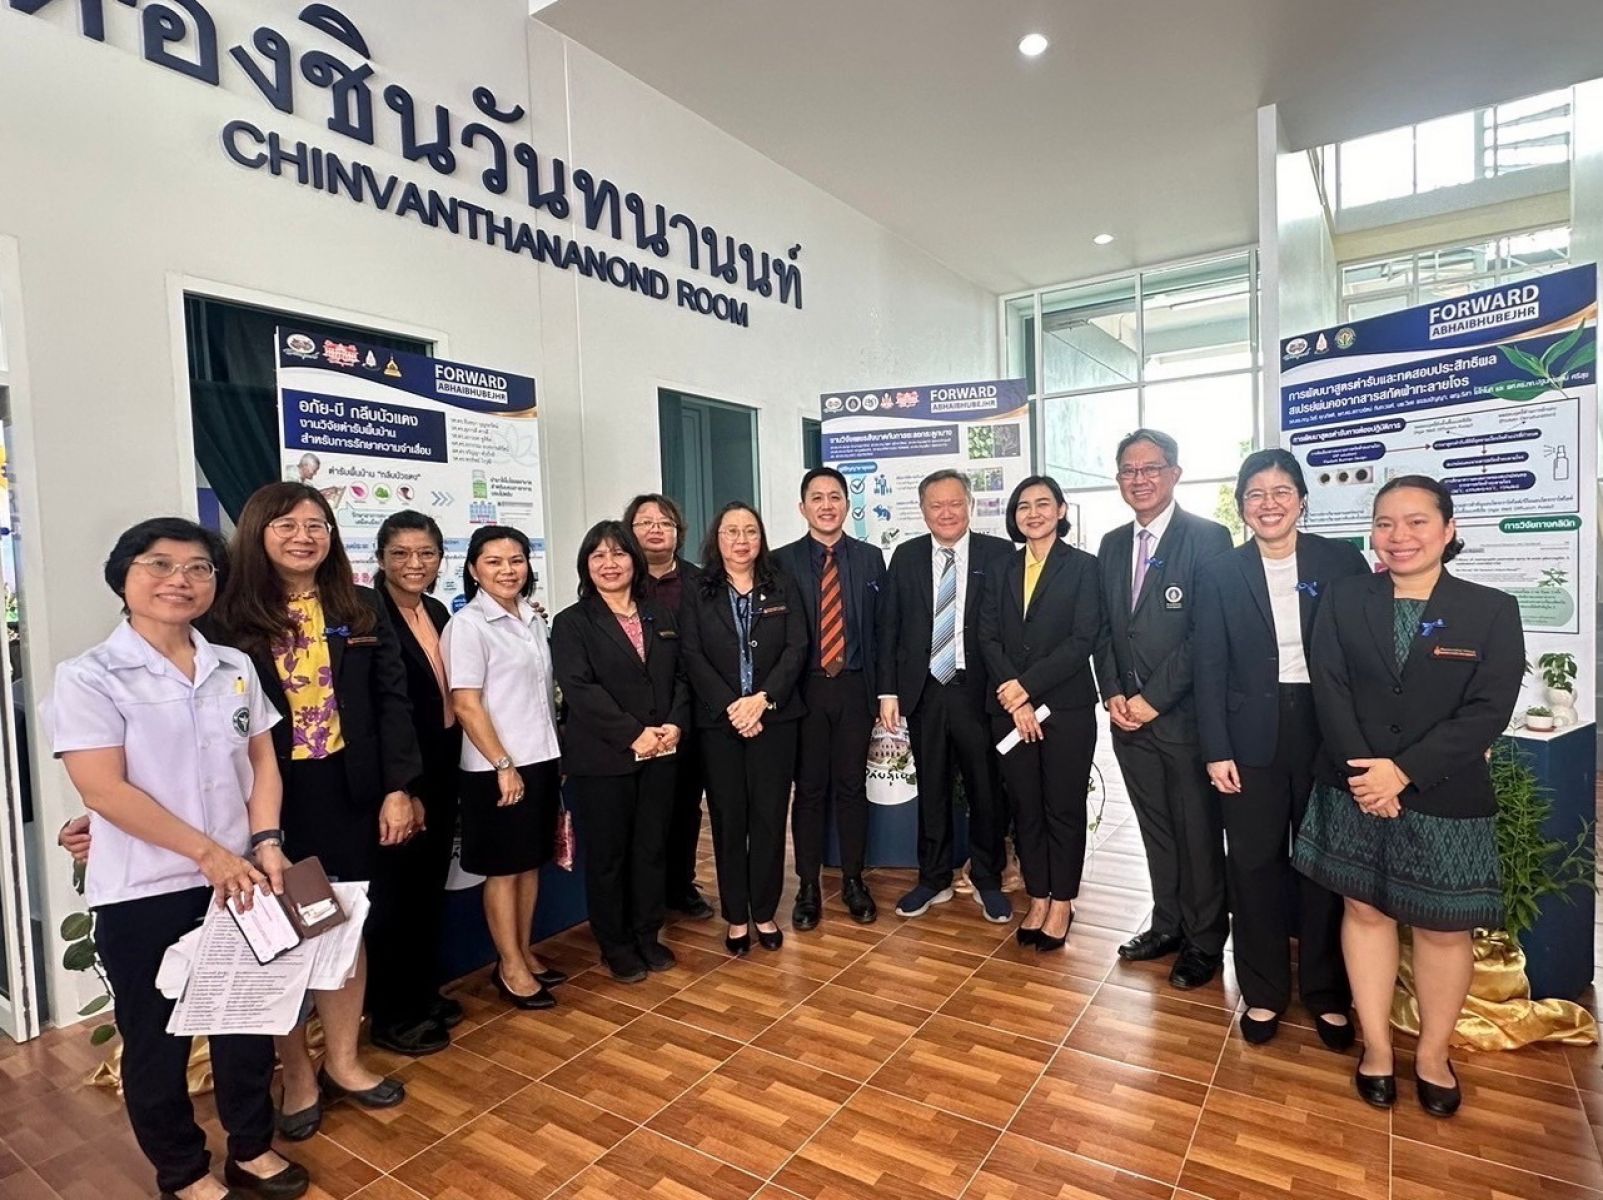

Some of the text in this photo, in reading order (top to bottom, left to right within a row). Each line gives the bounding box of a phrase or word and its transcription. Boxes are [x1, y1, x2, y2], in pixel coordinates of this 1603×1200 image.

[8, 0, 802, 310] องชินวันทนานนท์
[221, 119, 749, 328] CHINVANTHANANOND ROOM
[1430, 284, 1540, 325] FORWARD
[1431, 305, 1537, 337] ABHAIBHUBEJHR
[435, 364, 508, 391] FORWARD
[438, 382, 506, 402] ABHAIBHUBEJHR
[930, 385, 997, 402] FORWARD
[299, 398, 419, 426] อภัย-บี กลีบบัวแดง
[300, 418, 396, 438] งานวิจัยตำรับพื้นบ้าน
[301, 433, 431, 456] สำหรับการรักษาความจำเสื่อม
[1504, 518, 1576, 530] การวิจัยทางคลินิก
